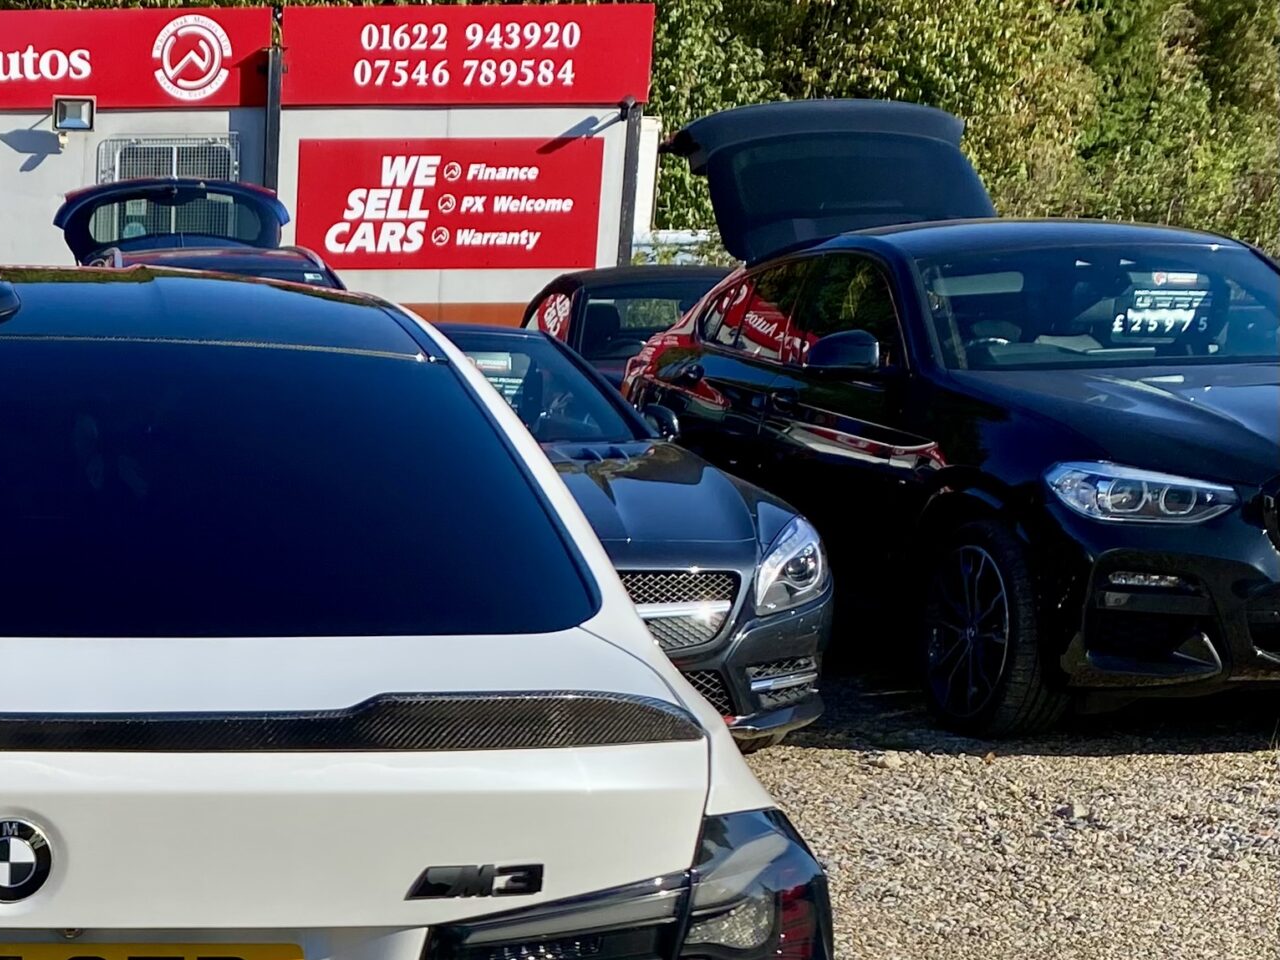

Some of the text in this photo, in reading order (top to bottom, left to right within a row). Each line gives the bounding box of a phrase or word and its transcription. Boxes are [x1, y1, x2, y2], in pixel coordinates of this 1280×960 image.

[361, 22, 581, 50] 01622 943920
[353, 59, 575, 86] 07546 789584
[380, 155, 441, 188] WE
[467, 164, 539, 181] Finance
[343, 188, 429, 220] SELL
[460, 196, 573, 213] PX Welcome
[324, 221, 426, 253] CARS
[456, 229, 541, 250] Warranty
